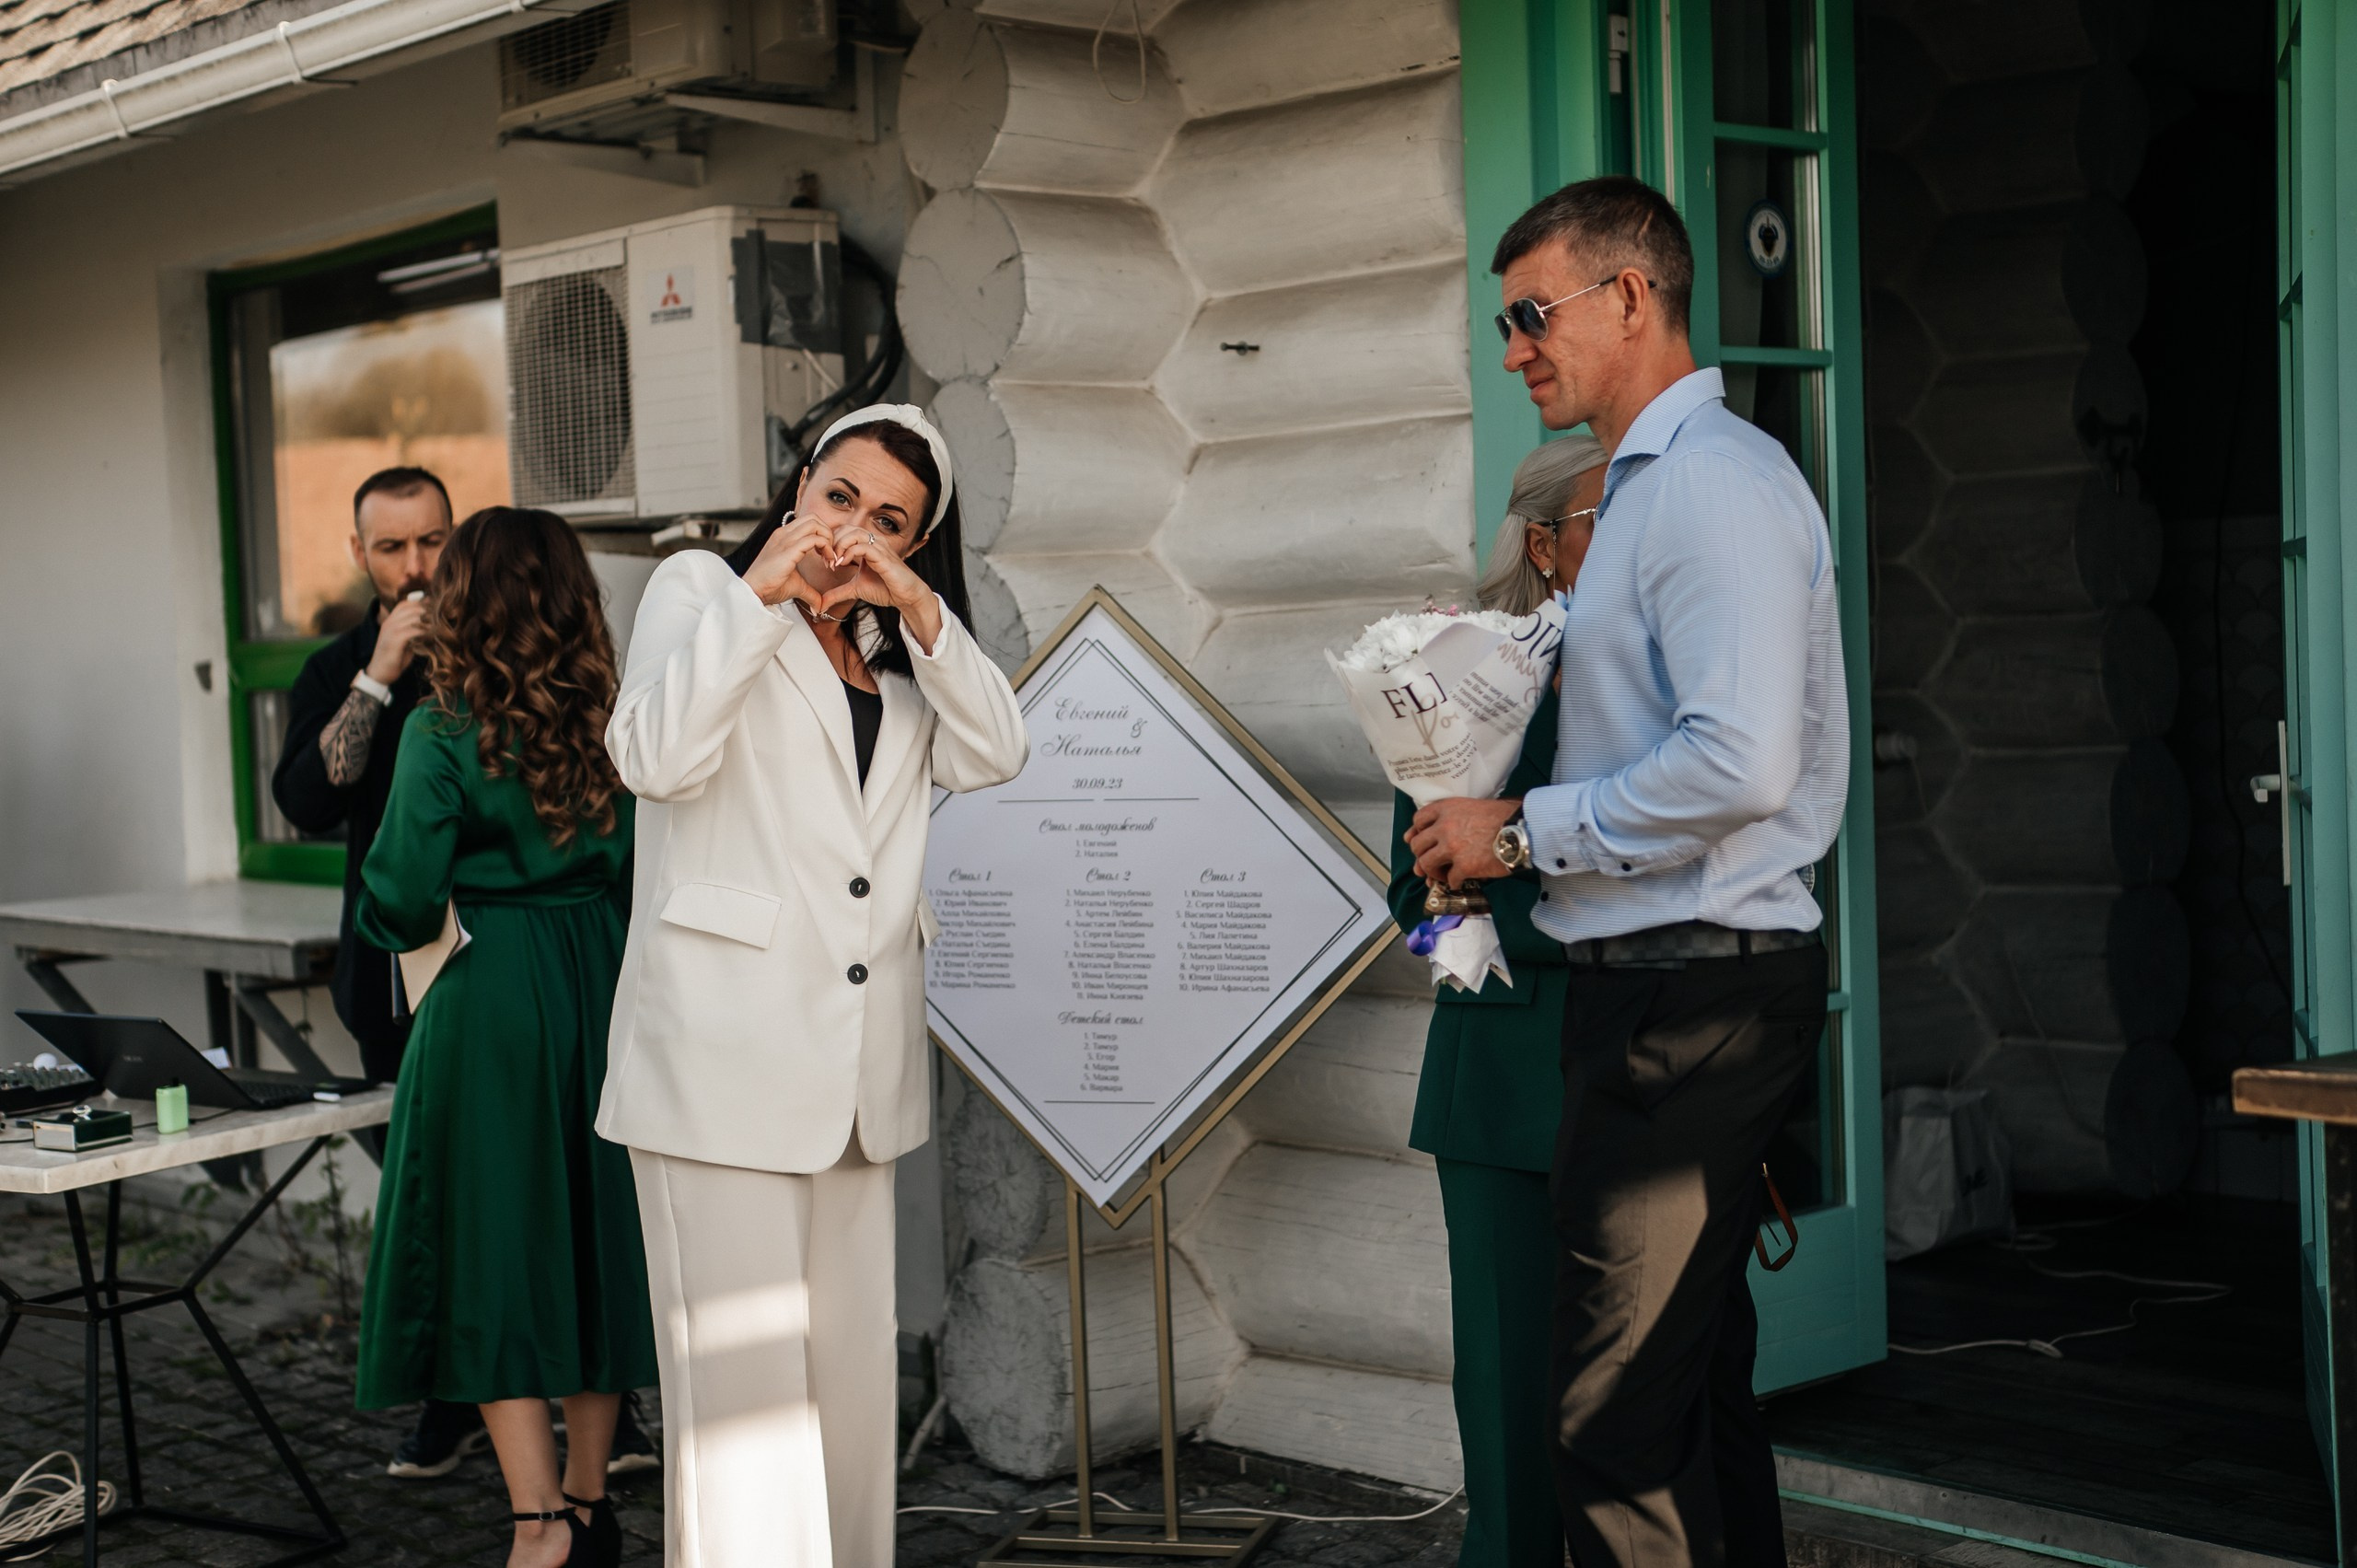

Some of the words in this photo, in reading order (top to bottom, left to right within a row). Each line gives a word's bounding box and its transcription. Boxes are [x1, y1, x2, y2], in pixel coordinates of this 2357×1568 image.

[1055, 697, 1128, 721] Евгений
[1131, 718, 1147, 738] &
[1040, 734, 1142, 757] Наталья
[1072, 777, 1123, 790] 30.09.23
[1039, 817, 1072, 836] Стол
[1075, 817, 1157, 836] молодоженов
[949, 868, 981, 882] Стол
[986, 870, 992, 882] 1
[1086, 868, 1119, 883] Стол
[1123, 870, 1131, 882] 2
[1200, 868, 1233, 883] Стол
[1237, 870, 1245, 882] 3
[1058, 1009, 1111, 1025] Детский
[1114, 1016, 1144, 1025] стол
